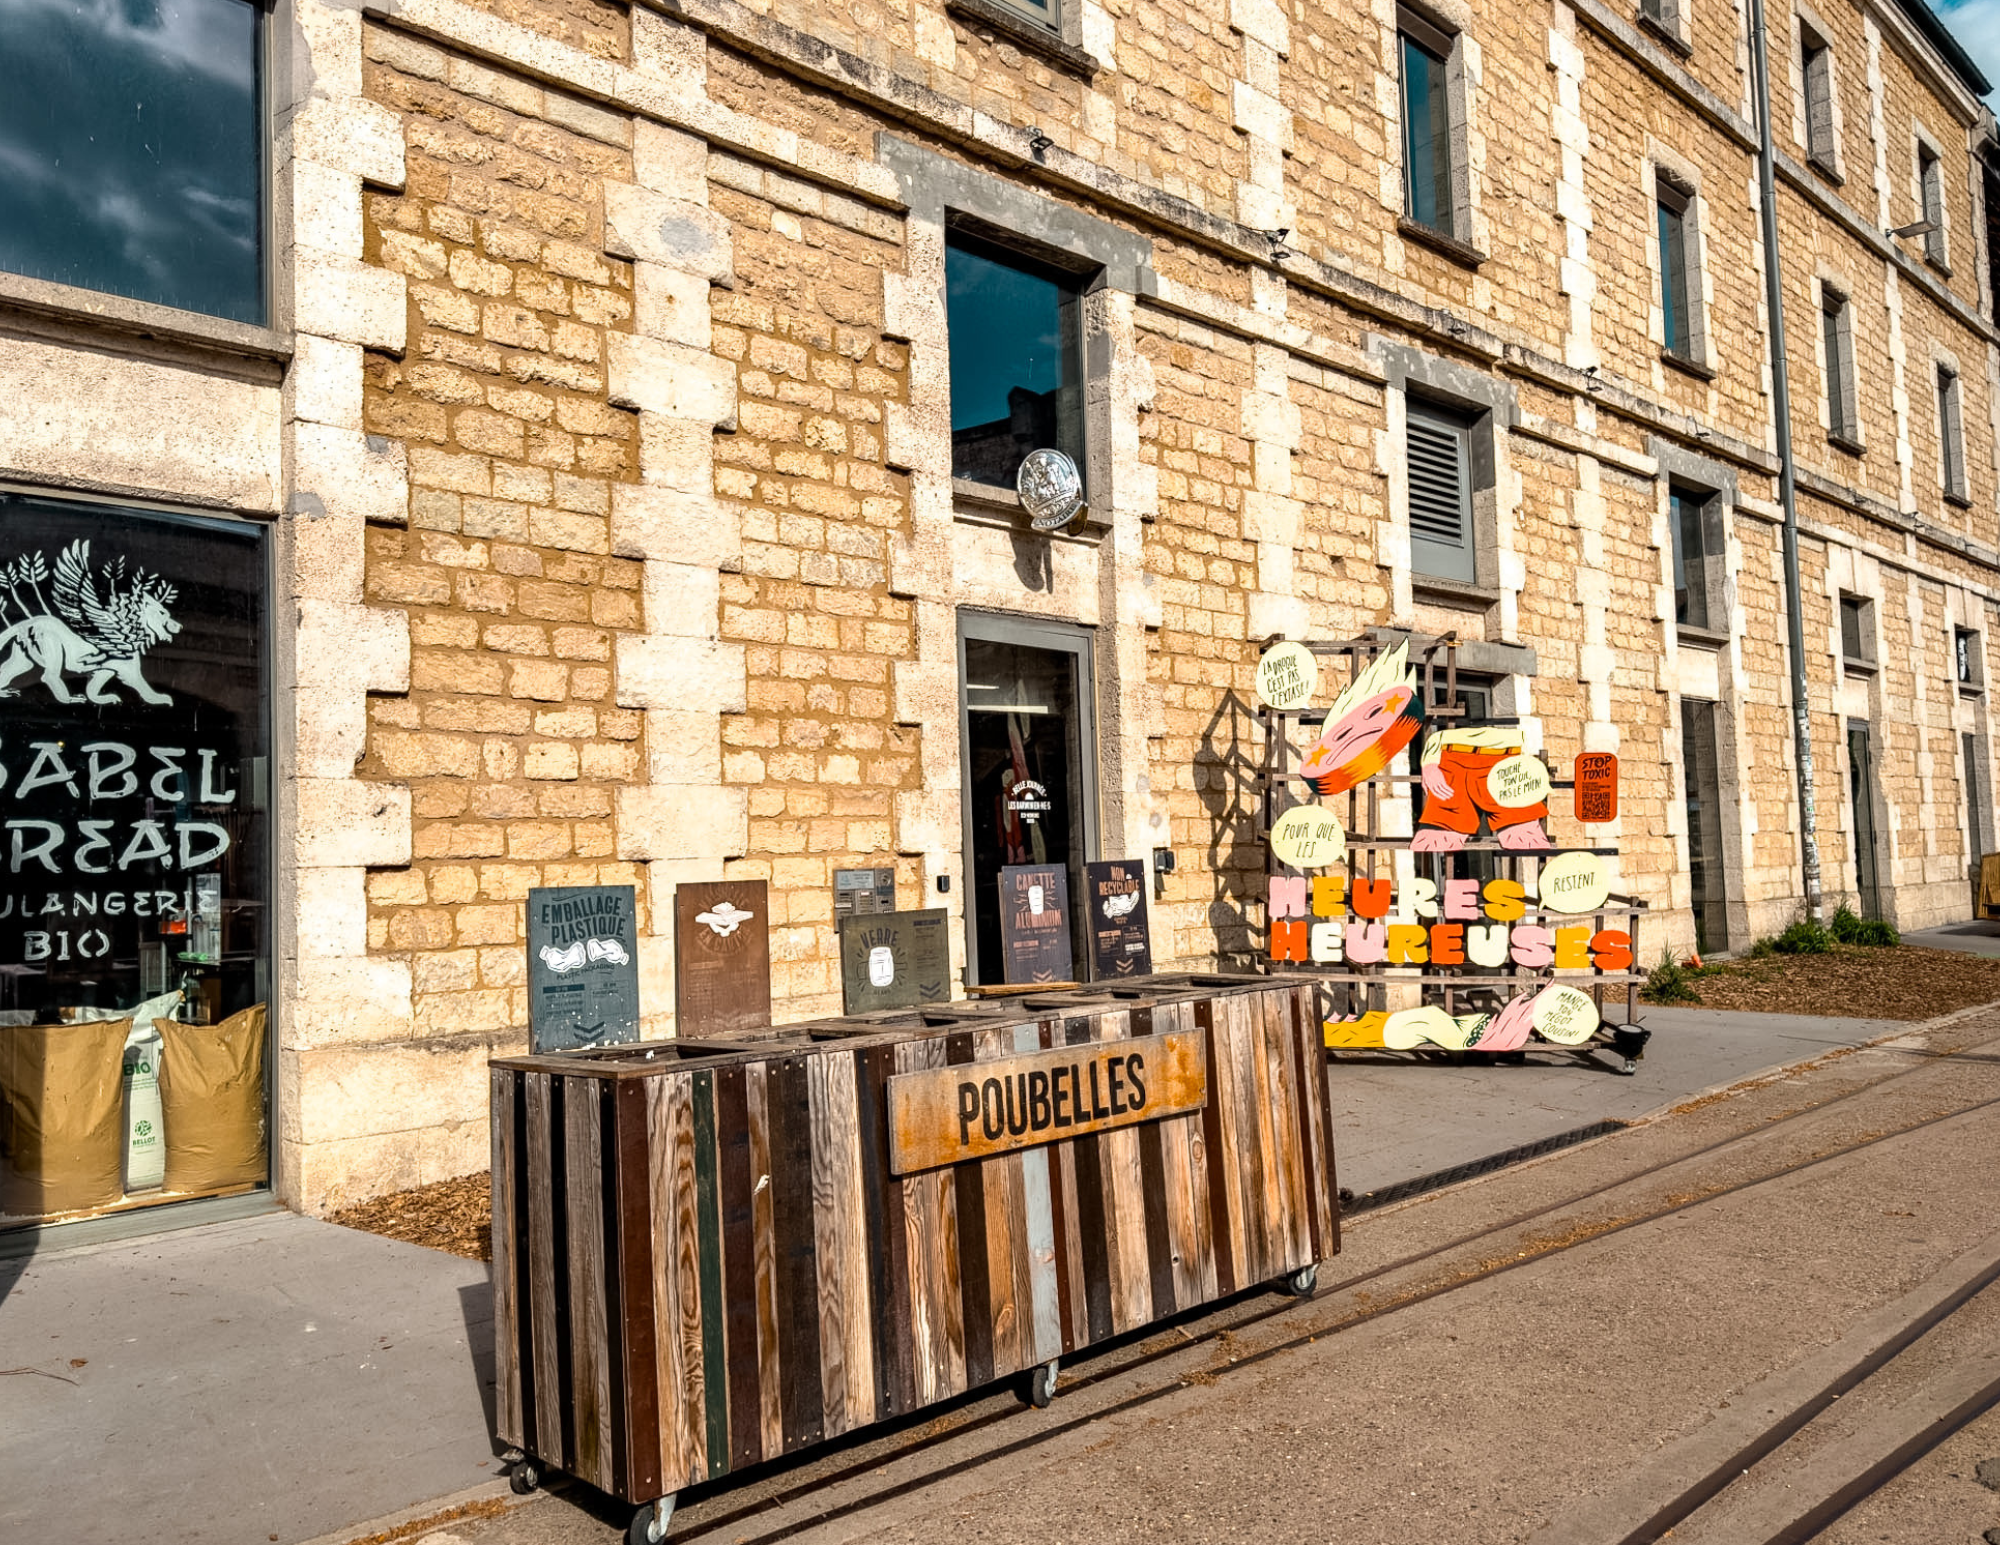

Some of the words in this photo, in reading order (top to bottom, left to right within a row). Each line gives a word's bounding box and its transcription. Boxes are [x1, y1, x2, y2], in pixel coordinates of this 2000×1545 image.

[1036, 502, 1078, 527] NOTAIRE
[1263, 660, 1272, 675] LA
[1288, 669, 1300, 684] PAS
[0, 736, 236, 804] ABEL
[1497, 761, 1521, 780] TOUCHE
[1582, 755, 1612, 770] STOP
[1582, 767, 1611, 781] TOXIC
[1499, 787, 1512, 800] PAS
[1513, 785, 1521, 797] LE
[1282, 822, 1310, 841] POUR
[1316, 822, 1335, 841] QUE
[0, 820, 230, 873] READ
[1110, 866, 1125, 881] NON
[1099, 879, 1140, 896] RECYCLABLE
[1268, 876, 1526, 921] HEURES
[541, 895, 622, 924] EMBALLAGE
[551, 916, 626, 945] PLASTIQUE
[860, 927, 899, 949] VERRE
[24, 929, 110, 961] BIO
[1270, 921, 1633, 970] HEUREUSES
[556, 970, 580, 981] PLASTIC
[581, 963, 615, 976] PACKAGING
[1556, 992, 1589, 1011] MANGE
[1559, 1004, 1573, 1016] TON
[123, 1061, 151, 1076] BIO
[958, 1053, 1146, 1146] POUBELLES
[132, 1136, 156, 1146] BELLOT
